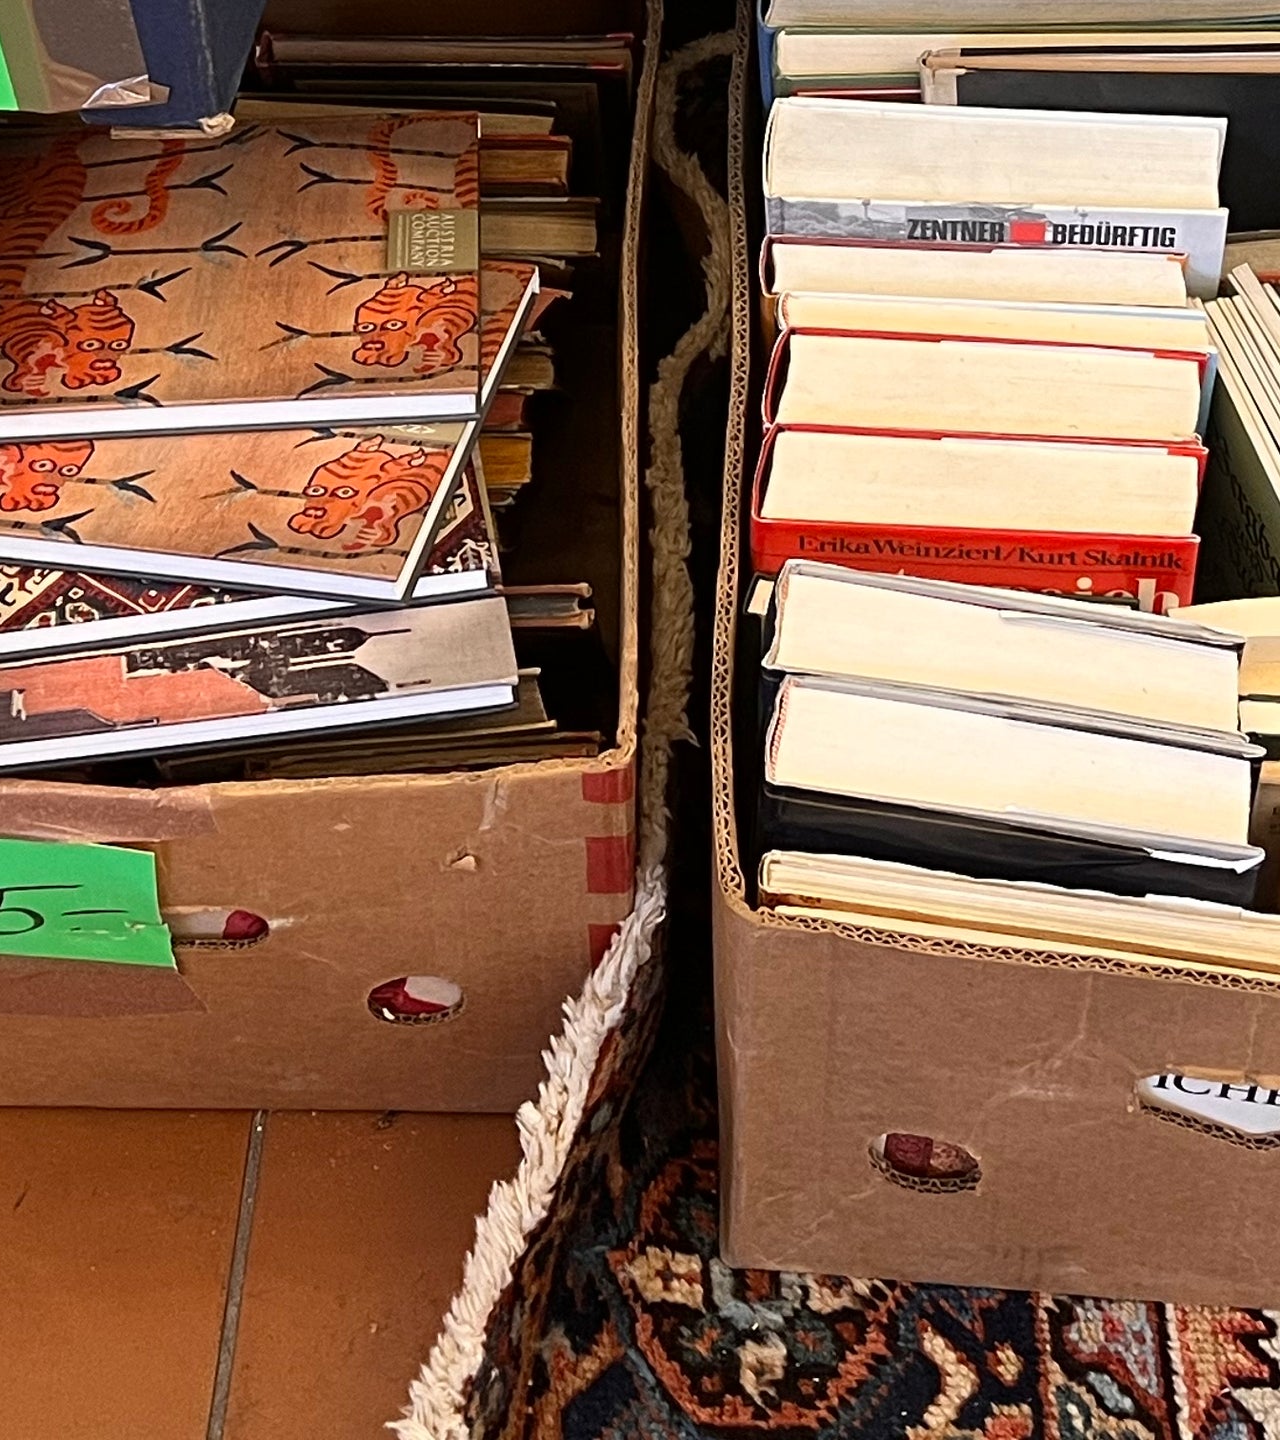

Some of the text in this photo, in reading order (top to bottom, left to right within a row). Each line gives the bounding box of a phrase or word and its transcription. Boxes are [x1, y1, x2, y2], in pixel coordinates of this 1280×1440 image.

[410, 213, 426, 267] COMPANY
[425, 213, 440, 267] AUCTION
[440, 213, 455, 266] AUSTRIA
[907, 218, 1176, 248] ZENTNER BEDÜRFTIG
[798, 534, 870, 555] Erika
[1083, 548, 1183, 571] Skalnik
